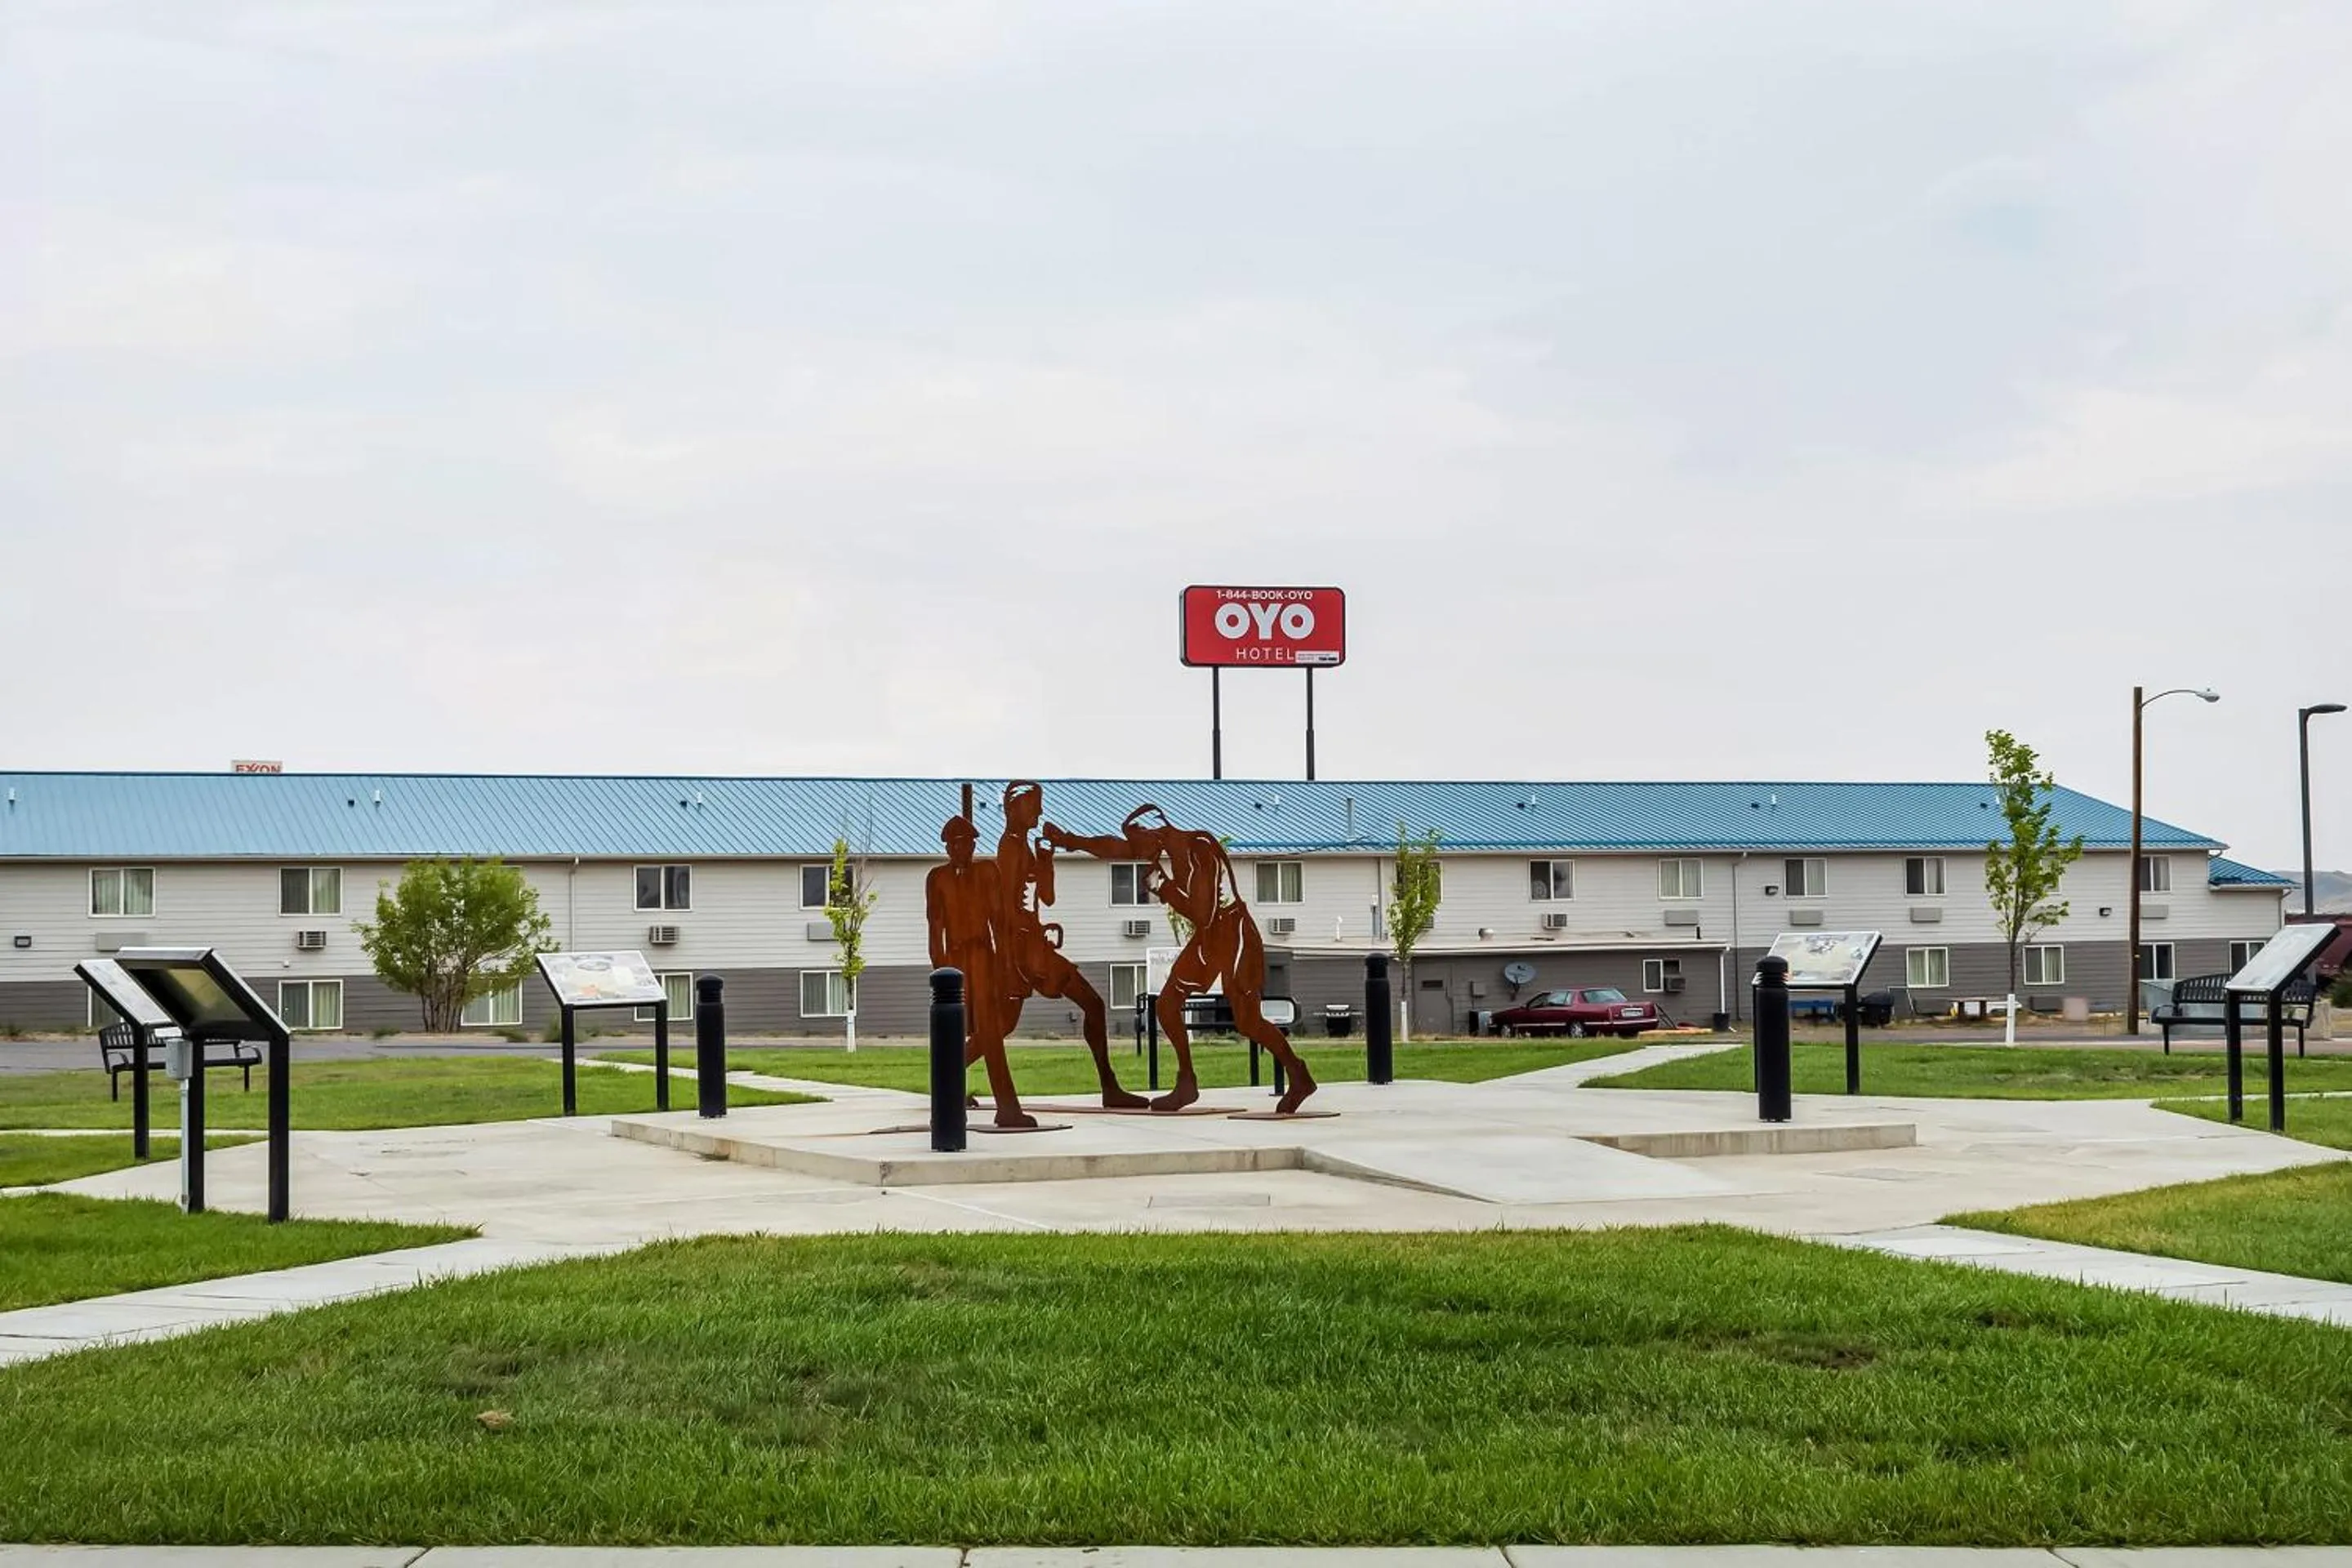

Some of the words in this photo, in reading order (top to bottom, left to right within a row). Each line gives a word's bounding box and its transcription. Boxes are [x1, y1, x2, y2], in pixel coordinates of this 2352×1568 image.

[1216, 590, 1313, 600] 1-844-BOOK-OYO
[1214, 603, 1315, 640] OYO
[1236, 647, 1294, 661] HOTEL
